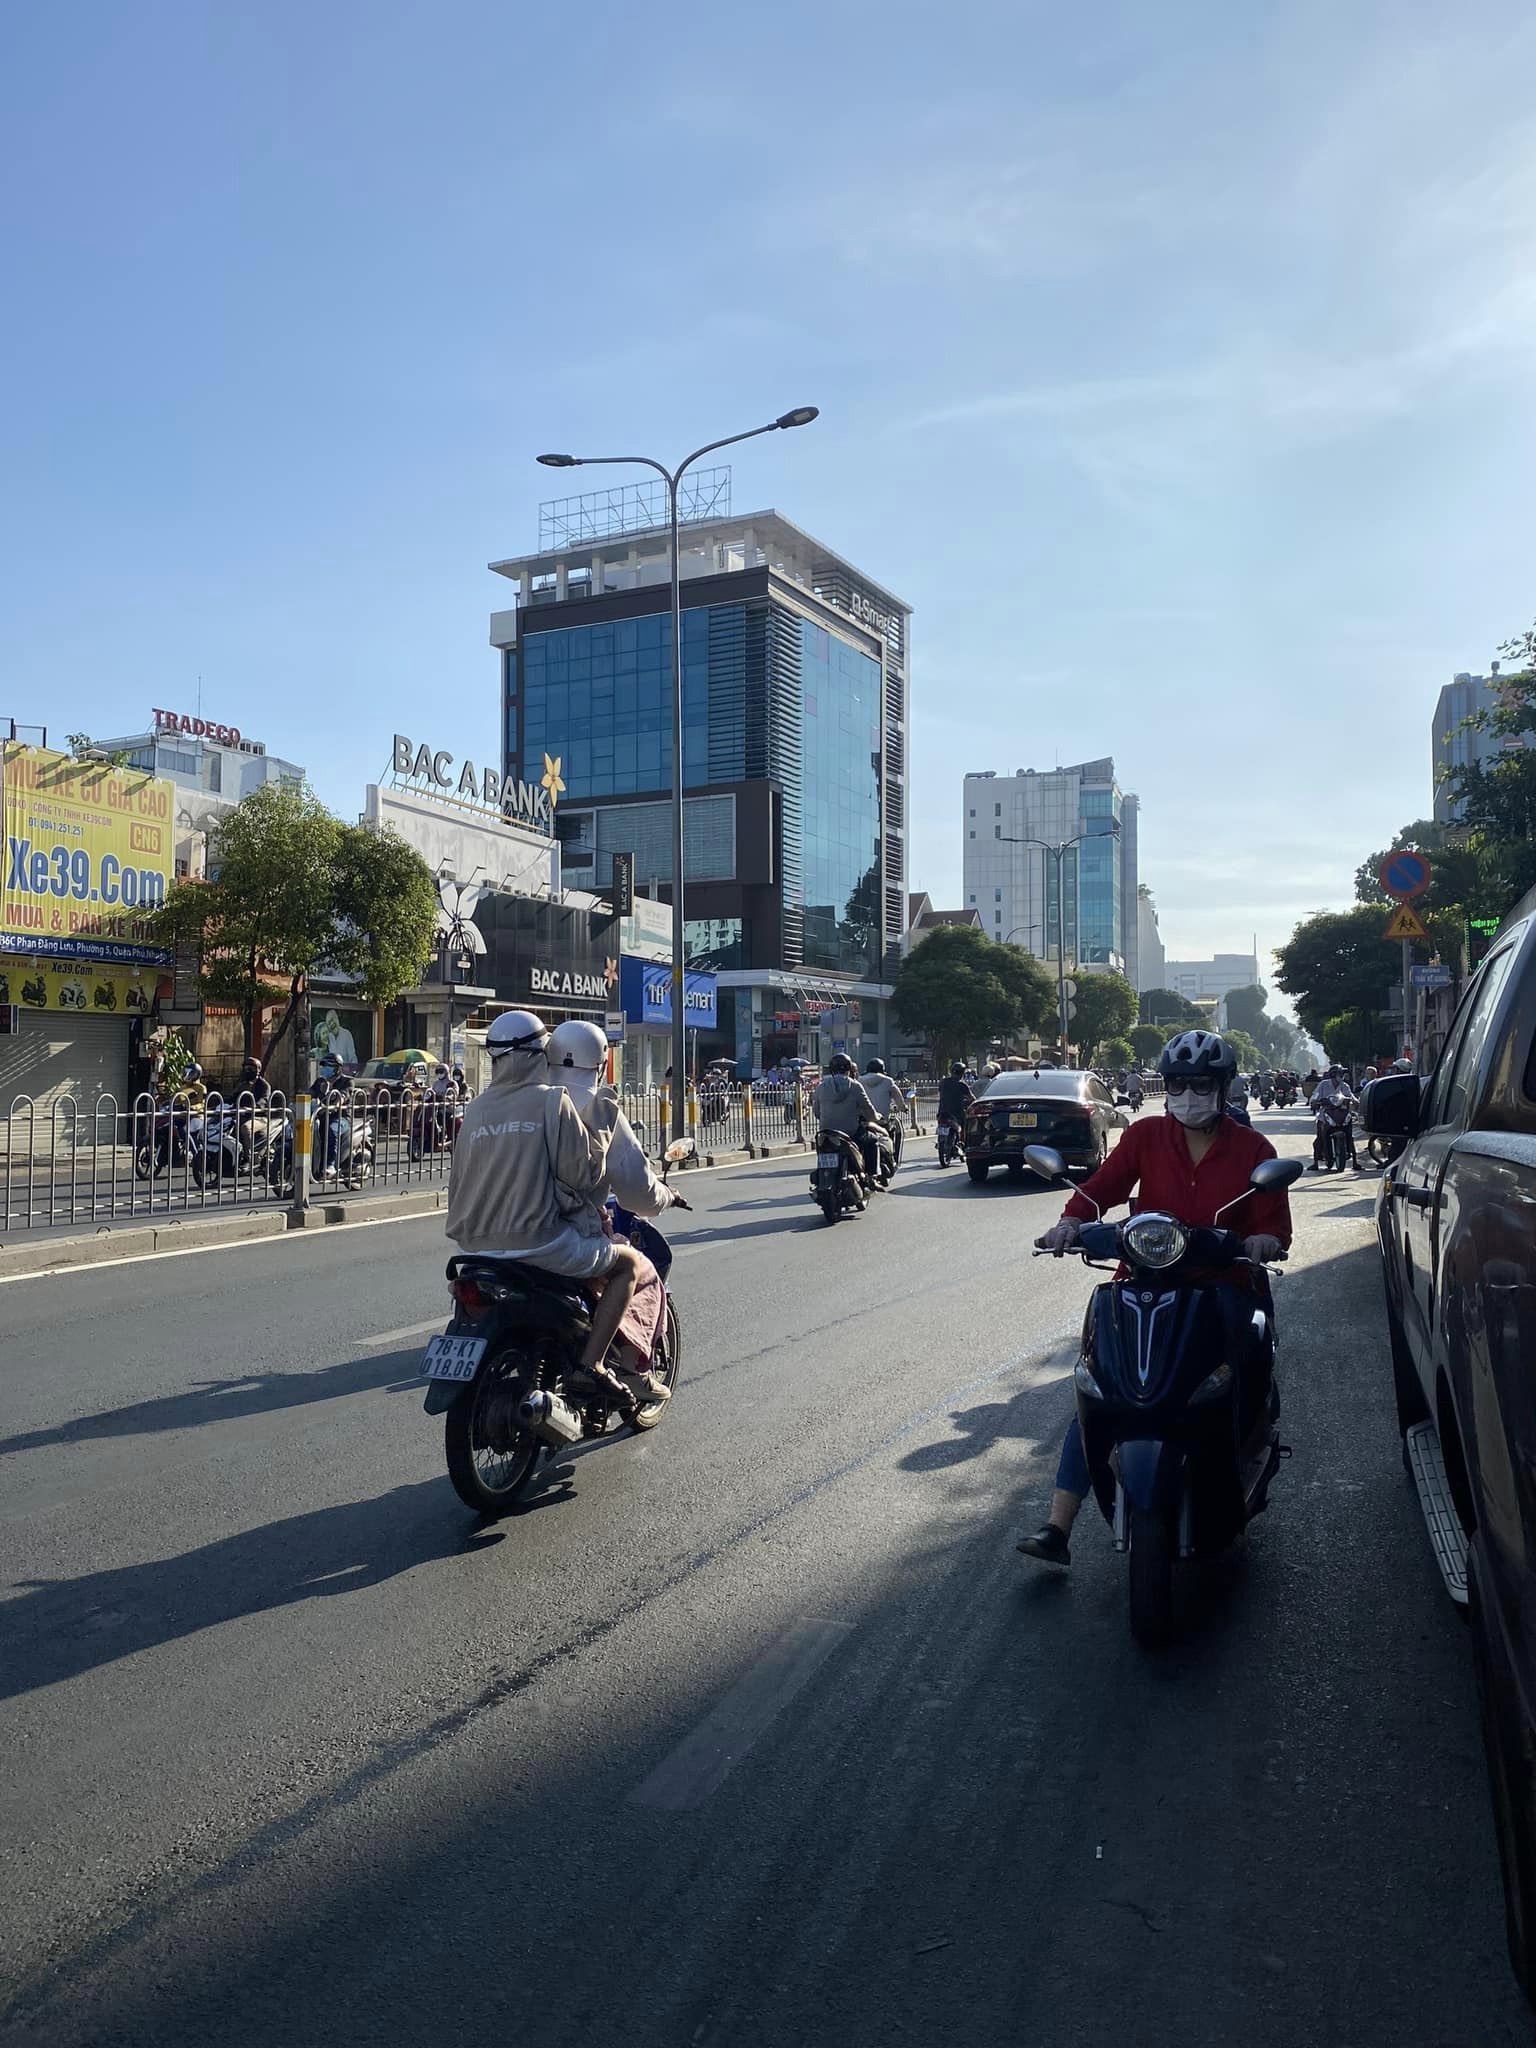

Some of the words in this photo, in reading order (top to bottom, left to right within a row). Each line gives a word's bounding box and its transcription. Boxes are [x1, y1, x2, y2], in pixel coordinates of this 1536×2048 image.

[152, 707, 241, 745] TRADECO
[394, 734, 454, 788] BAC
[459, 760, 479, 798] A
[484, 767, 549, 821] BANK
[138, 787, 167, 818] CAO
[133, 825, 158, 851] CN6
[7, 837, 165, 911] Xe39.Com
[6, 903, 45, 929] MUA
[51, 909, 63, 931] &
[69, 908, 102, 936] BÁN
[107, 915, 127, 938] XE
[17, 937, 37, 948] Phan
[38, 938, 58, 952] Đăng
[76, 943, 104, 956] Phường
[113, 947, 132, 959] Quận
[51, 962, 93, 976] Xe39.Com
[531, 968, 560, 993] BAC
[562, 973, 573, 994] A
[574, 973, 608, 997] BANK
[648, 984, 664, 1004] TH
